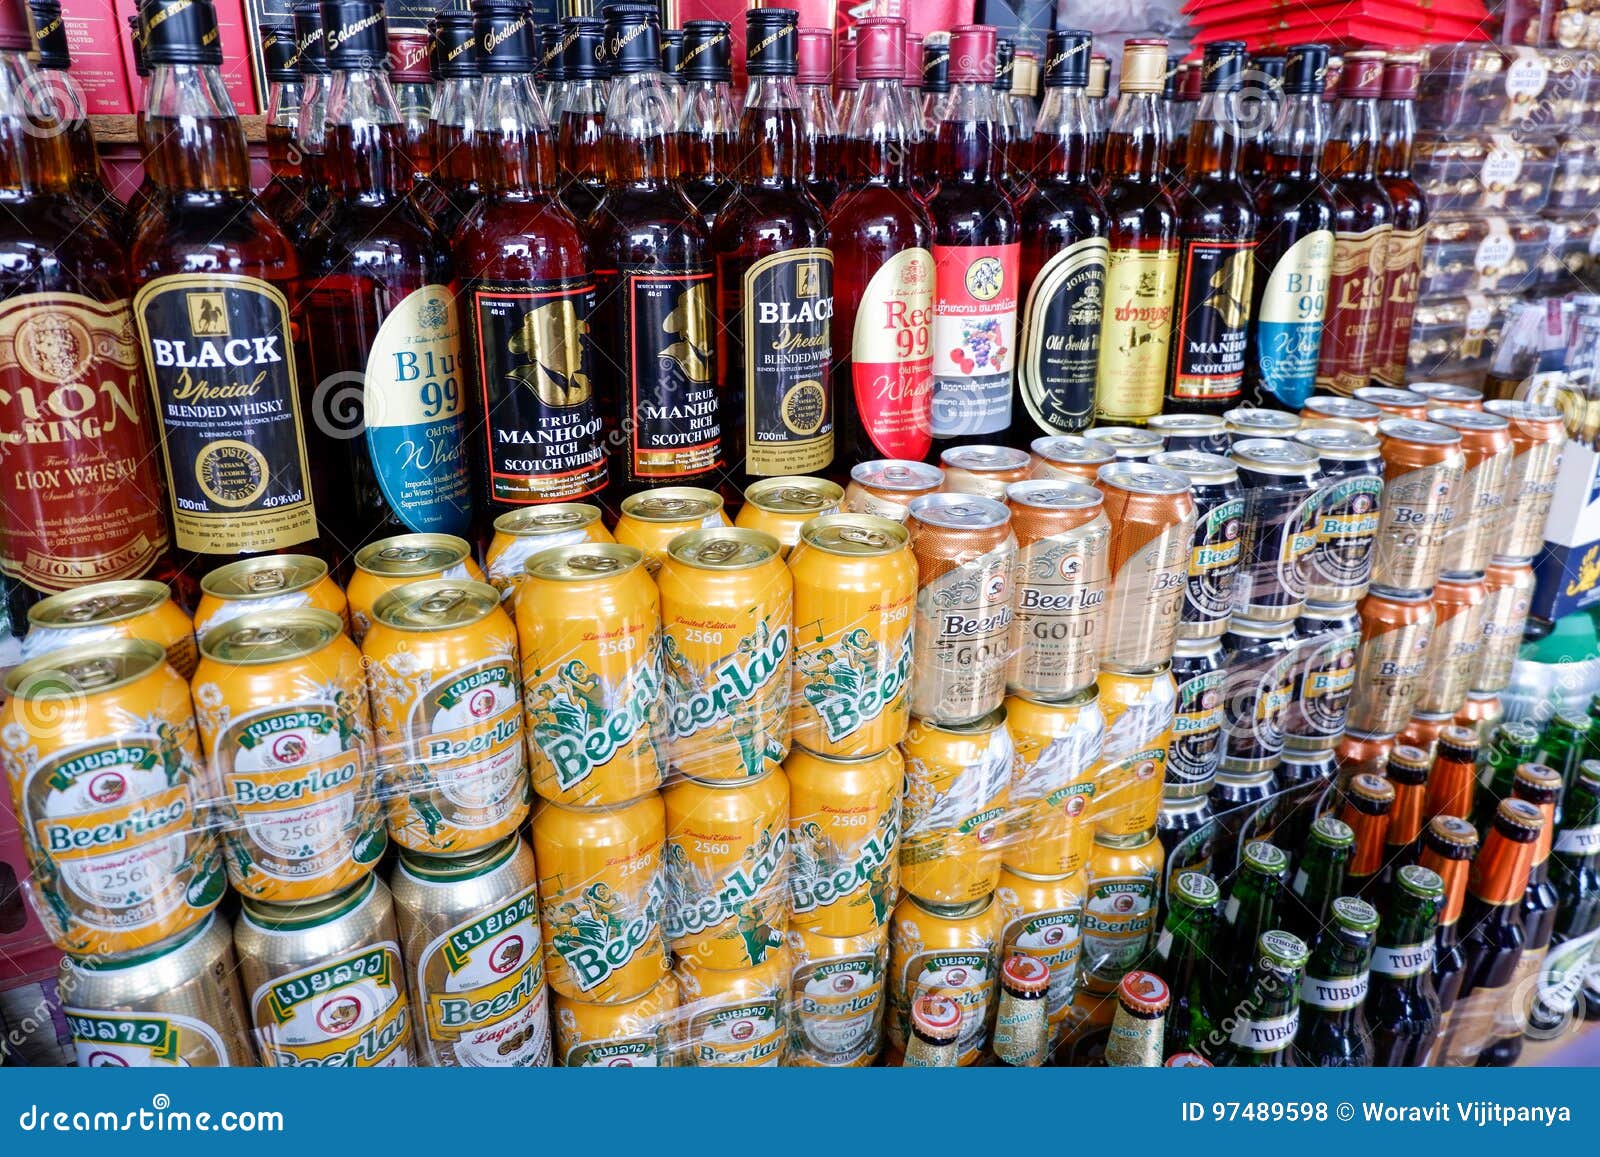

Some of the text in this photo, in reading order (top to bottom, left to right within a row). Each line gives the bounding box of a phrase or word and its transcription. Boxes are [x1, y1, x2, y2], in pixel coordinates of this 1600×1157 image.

[484, 13, 527, 54] Scotland
[611, 14, 650, 56] Scotland
[758, 296, 834, 324] BLACK
[1298, 295, 1324, 319] 99
[152, 335, 282, 368] BLACK
[896, 326, 929, 358] 99
[1046, 334, 1091, 351] Old Scotch
[764, 352, 812, 365] BLENDED
[172, 367, 267, 405] Special
[420, 376, 460, 418] 99
[685, 388, 714, 402] TRUE
[168, 399, 284, 418] BLENDED WHISKY
[539, 413, 581, 428] TRUE
[24, 416, 101, 444] KING
[426, 426, 441, 438] Old
[498, 417, 603, 444] MANHOOD
[690, 415, 713, 430] RICH
[1048, 413, 1074, 429] Black
[545, 441, 578, 457] RICH
[651, 430, 702, 446] SCOTCH
[504, 445, 603, 471] SCOTCH WHISKY
[15, 457, 138, 490] LION WHISKY
[34, 547, 140, 577] LION KING
[704, 620, 737, 630] Edition
[880, 606, 908, 625] 2560
[685, 628, 723, 645] 2560
[1034, 619, 1095, 640] GOLD
[597, 636, 636, 657] 2560
[234, 762, 355, 803] Beerlao
[48, 798, 187, 851] Beerlao
[831, 814, 868, 827] 2560
[694, 841, 729, 855] 2560
[620, 854, 652, 878] 2560
[453, 893, 535, 952] ເບຍລາວ
[276, 953, 382, 1005] ເບຍລາວ
[803, 989, 878, 1015] Beerlao
[472, 1020, 519, 1045] Lager
